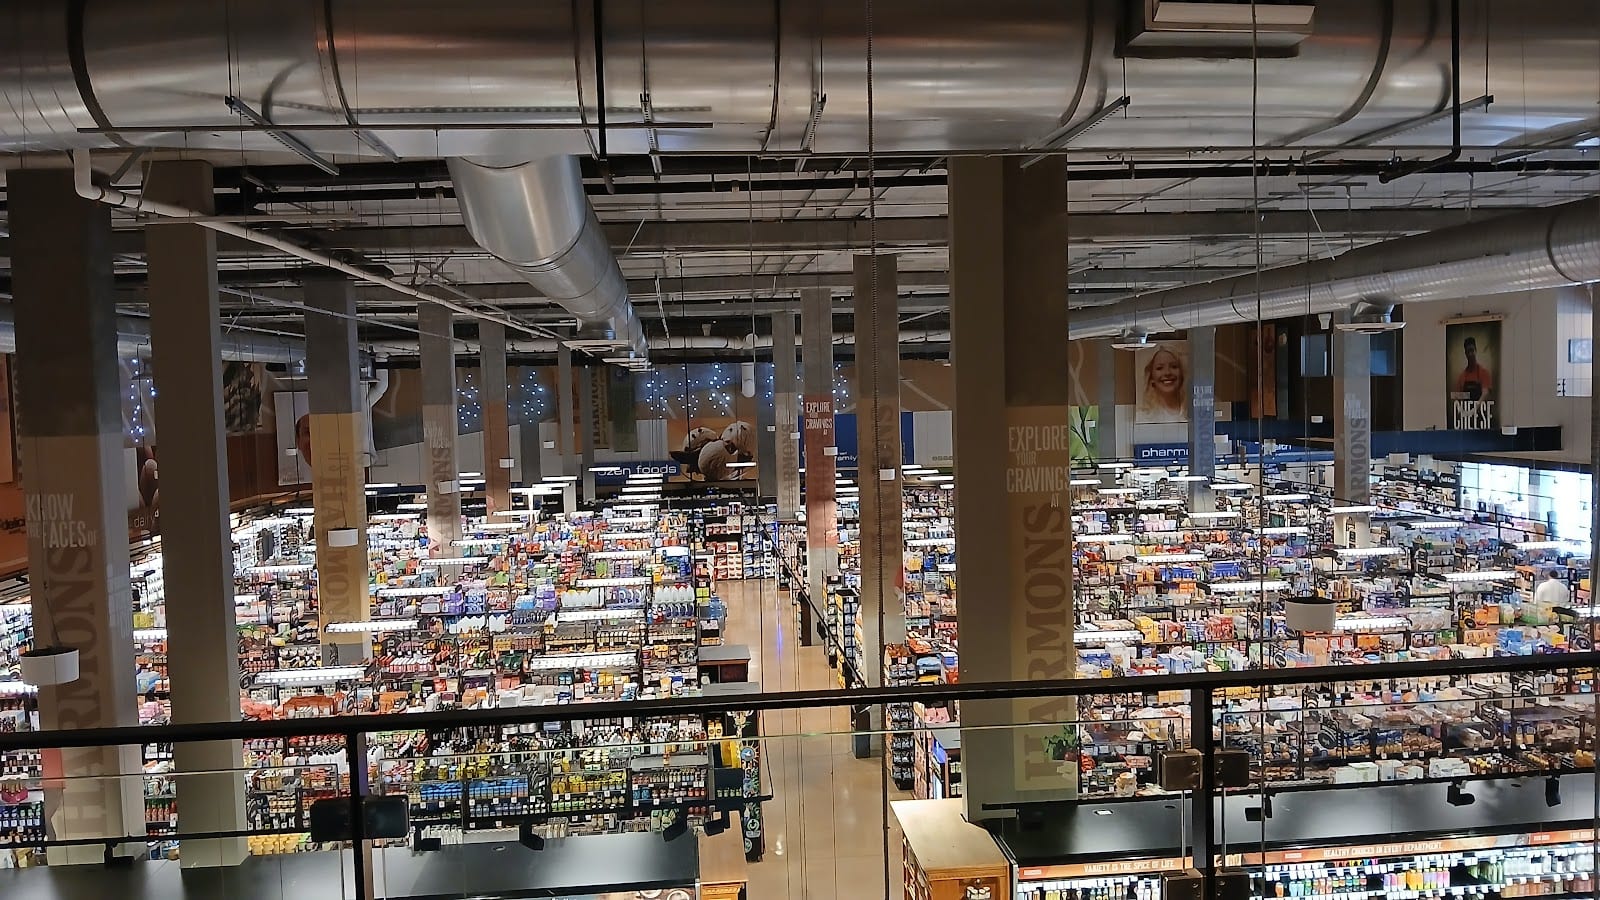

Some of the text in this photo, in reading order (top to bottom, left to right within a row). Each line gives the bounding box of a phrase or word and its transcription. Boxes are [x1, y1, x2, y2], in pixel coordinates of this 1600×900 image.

[1008, 424, 1068, 452] EXPLORE
[1015, 451, 1037, 466] YOUR
[1141, 446, 1188, 459] pharm
[636, 465, 677, 475] foods
[1006, 466, 1071, 493] CRAVINGS
[25, 493, 74, 521] KNOW
[1050, 493, 1060, 508] AT
[42, 520, 87, 549] FACES
[1023, 501, 1069, 782] HARMONS
